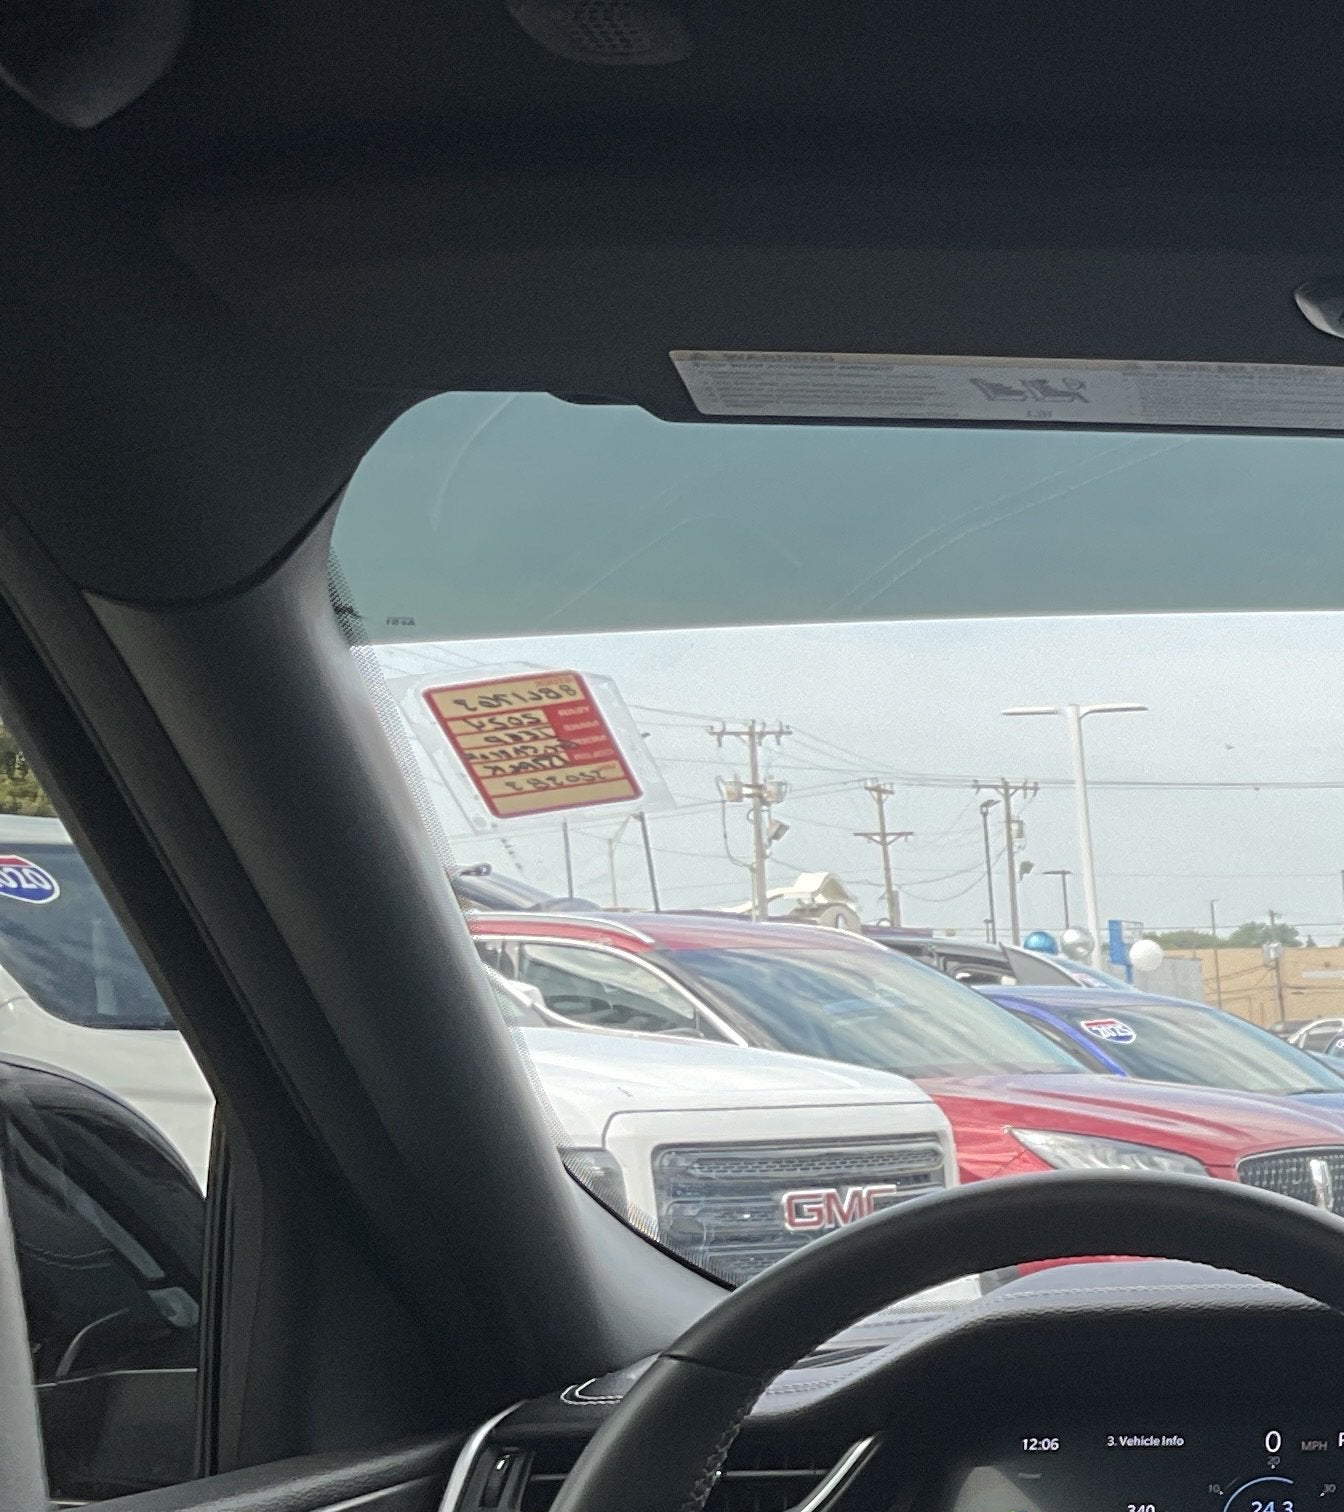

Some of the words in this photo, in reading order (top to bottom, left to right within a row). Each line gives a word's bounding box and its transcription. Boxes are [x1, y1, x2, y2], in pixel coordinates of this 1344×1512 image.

[1022, 1437, 1060, 1451] 12:06
[1107, 1435, 1118, 1447] 3.
[1119, 1435, 1160, 1447] Vehicle
[1162, 1435, 1185, 1447] Info
[1265, 1430, 1282, 1453] 0
[1301, 1440, 1328, 1451] MPH
